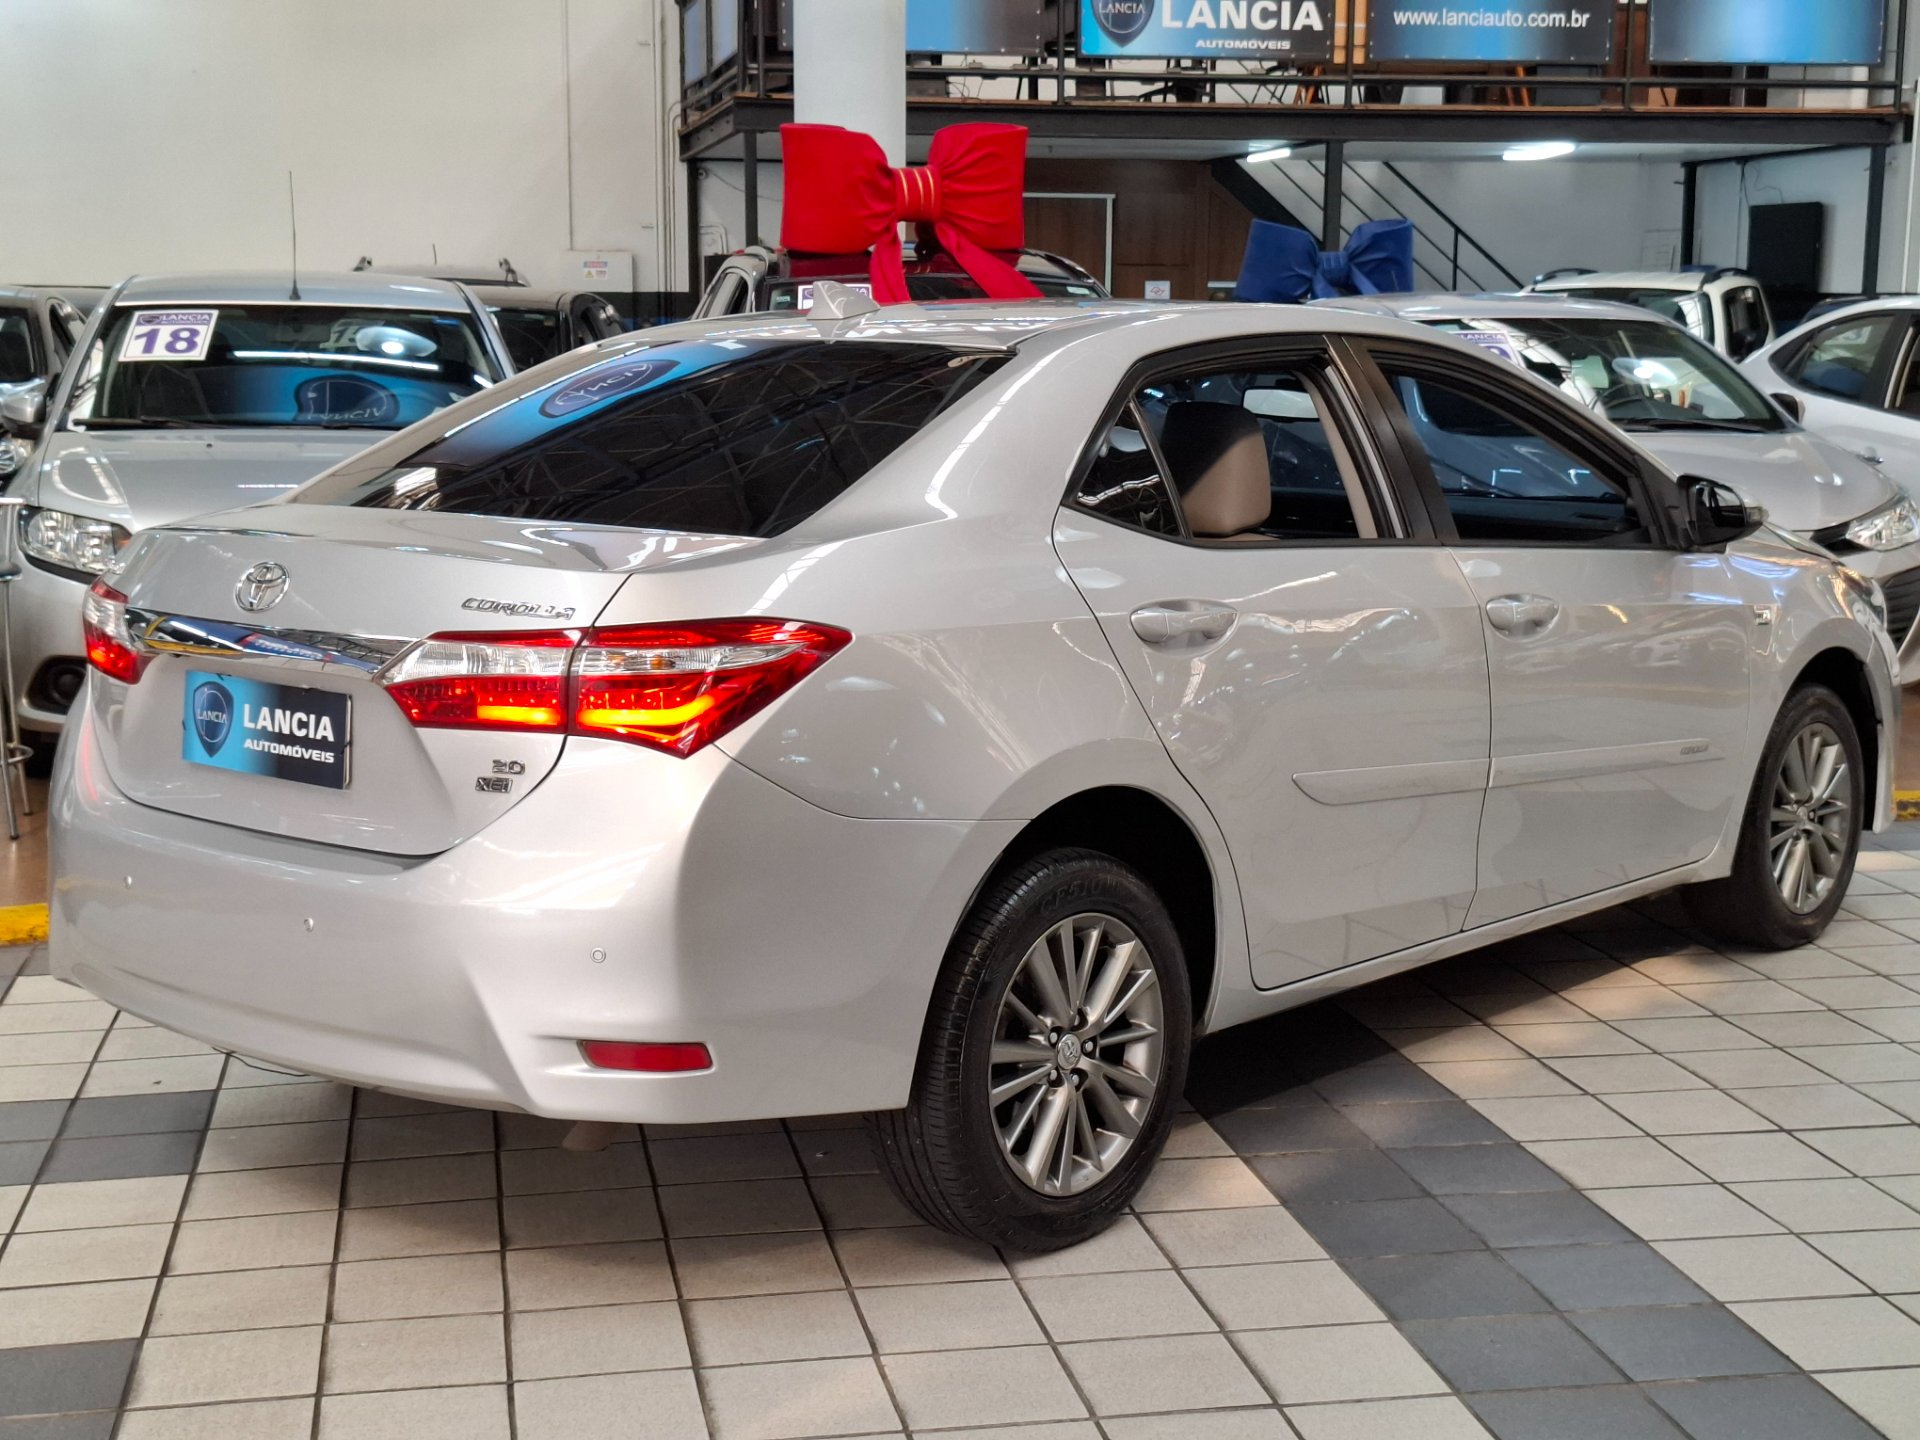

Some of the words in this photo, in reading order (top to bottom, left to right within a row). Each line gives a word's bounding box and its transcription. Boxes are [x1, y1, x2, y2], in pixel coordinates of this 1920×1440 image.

[1099, 2, 1145, 14] LANCIA
[1162, 0, 1323, 31] LANCIA
[1393, 8, 1590, 28] www.lanciauto.com.br
[1195, 39, 1291, 50] AUTOMÓVEIS
[162, 313, 210, 321] LANCIA
[134, 327, 201, 354] 18
[461, 597, 576, 620] COROLLA
[197, 709, 228, 724] LANCIA
[243, 703, 335, 742] LANCIA
[243, 738, 335, 763] AUTOMÓVEIS
